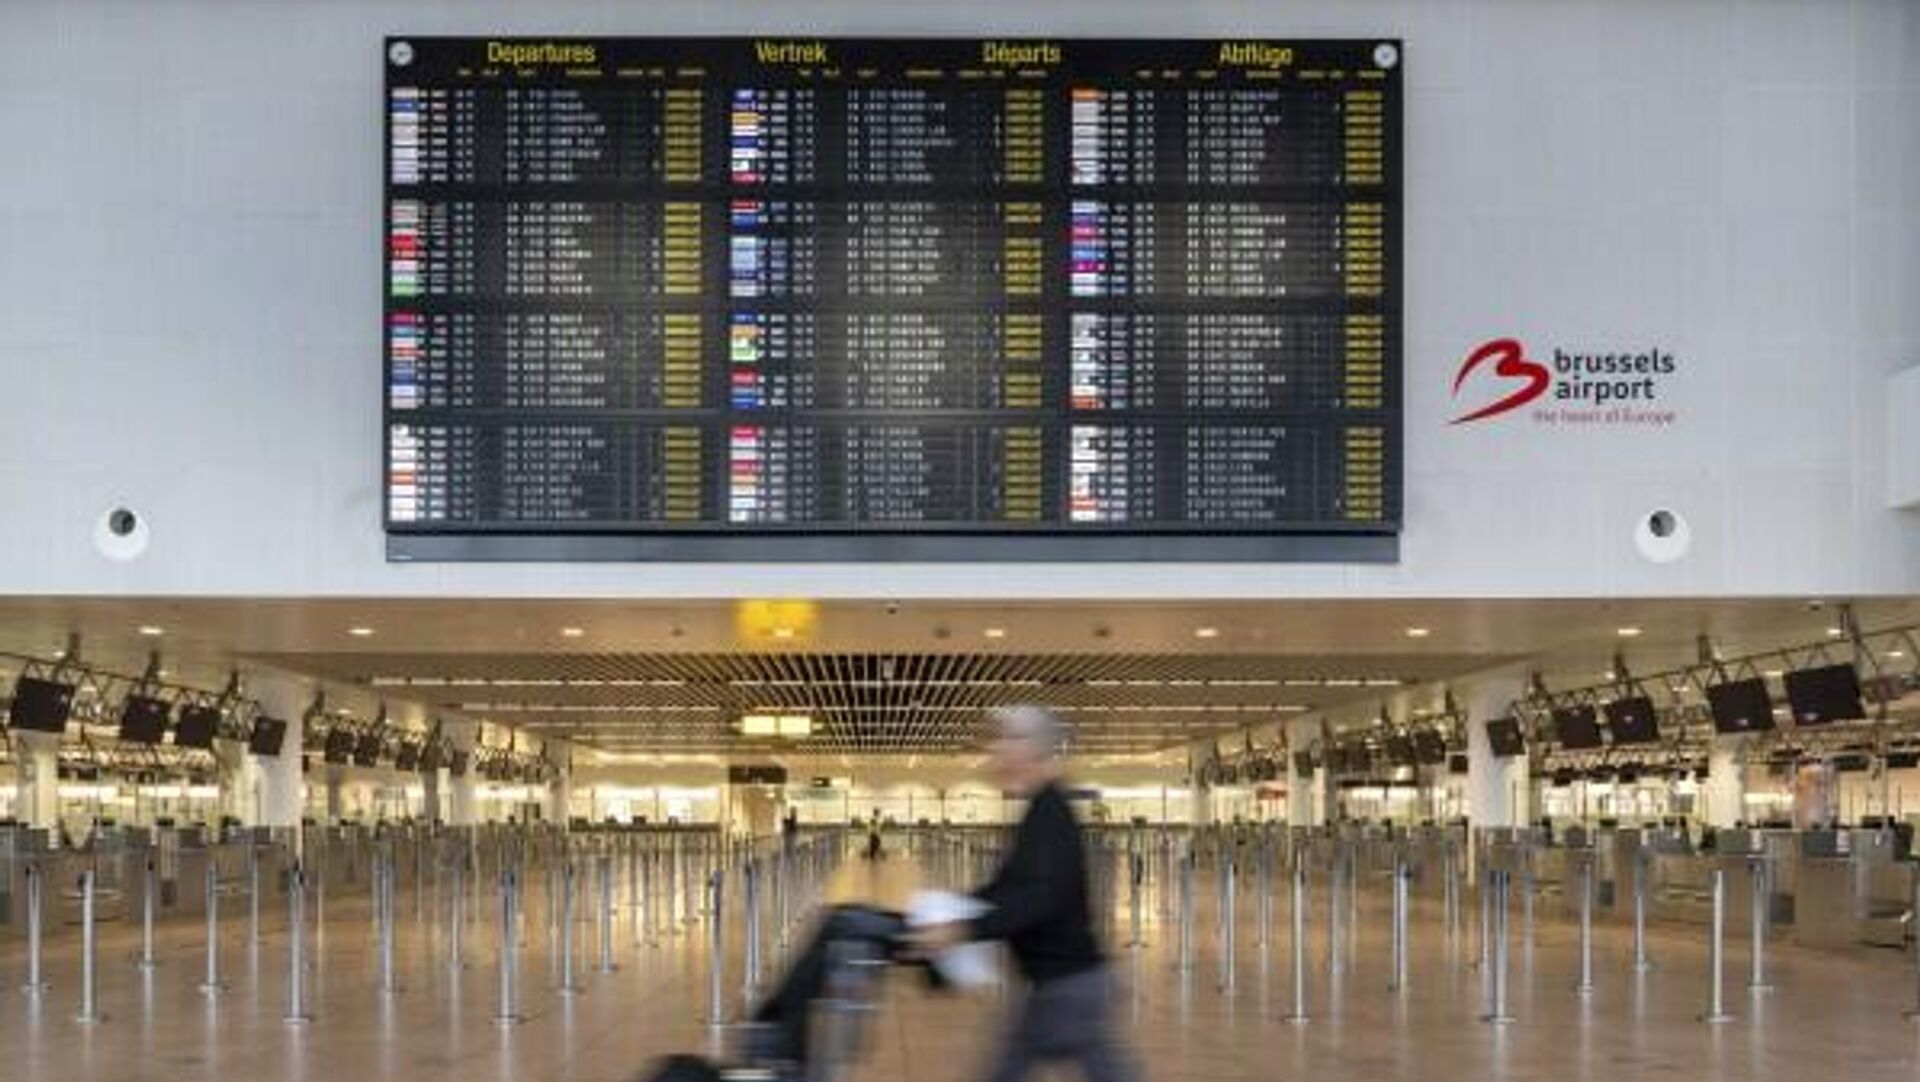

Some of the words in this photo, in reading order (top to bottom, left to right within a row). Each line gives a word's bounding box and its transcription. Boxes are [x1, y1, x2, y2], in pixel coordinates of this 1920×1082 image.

[487, 41, 596, 66] Departures
[755, 41, 827, 63] Vertrek
[983, 41, 1061, 68] Départs
[1219, 41, 1292, 69] Abflüge
[1554, 347, 1676, 374] brussels
[1555, 375, 1655, 406] airport
